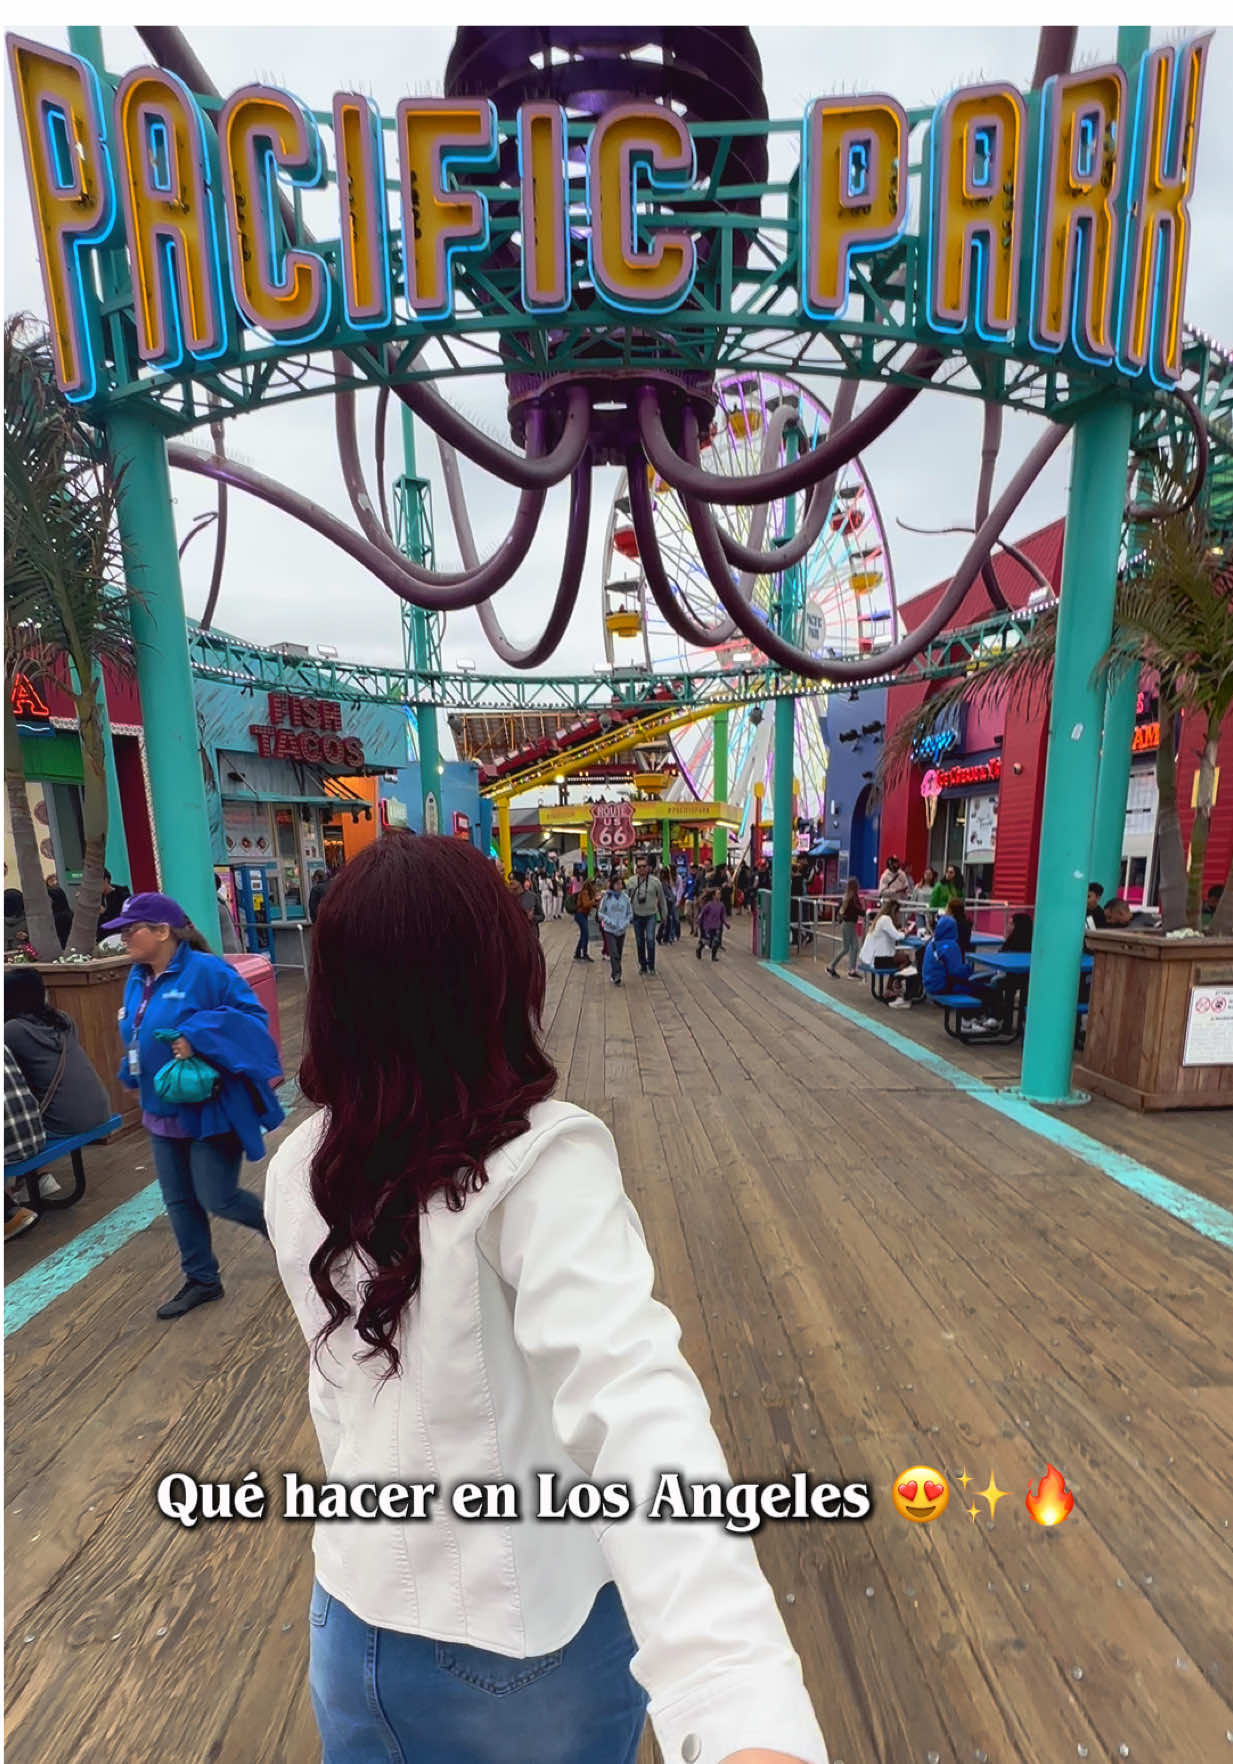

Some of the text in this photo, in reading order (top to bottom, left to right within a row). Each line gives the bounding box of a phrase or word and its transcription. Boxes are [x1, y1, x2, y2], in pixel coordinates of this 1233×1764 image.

[6, 31, 1216, 403] PACIFIC PARK
[268, 692, 342, 731] FISH
[249, 724, 365, 768] TACOS
[600, 826, 627, 845] 66
